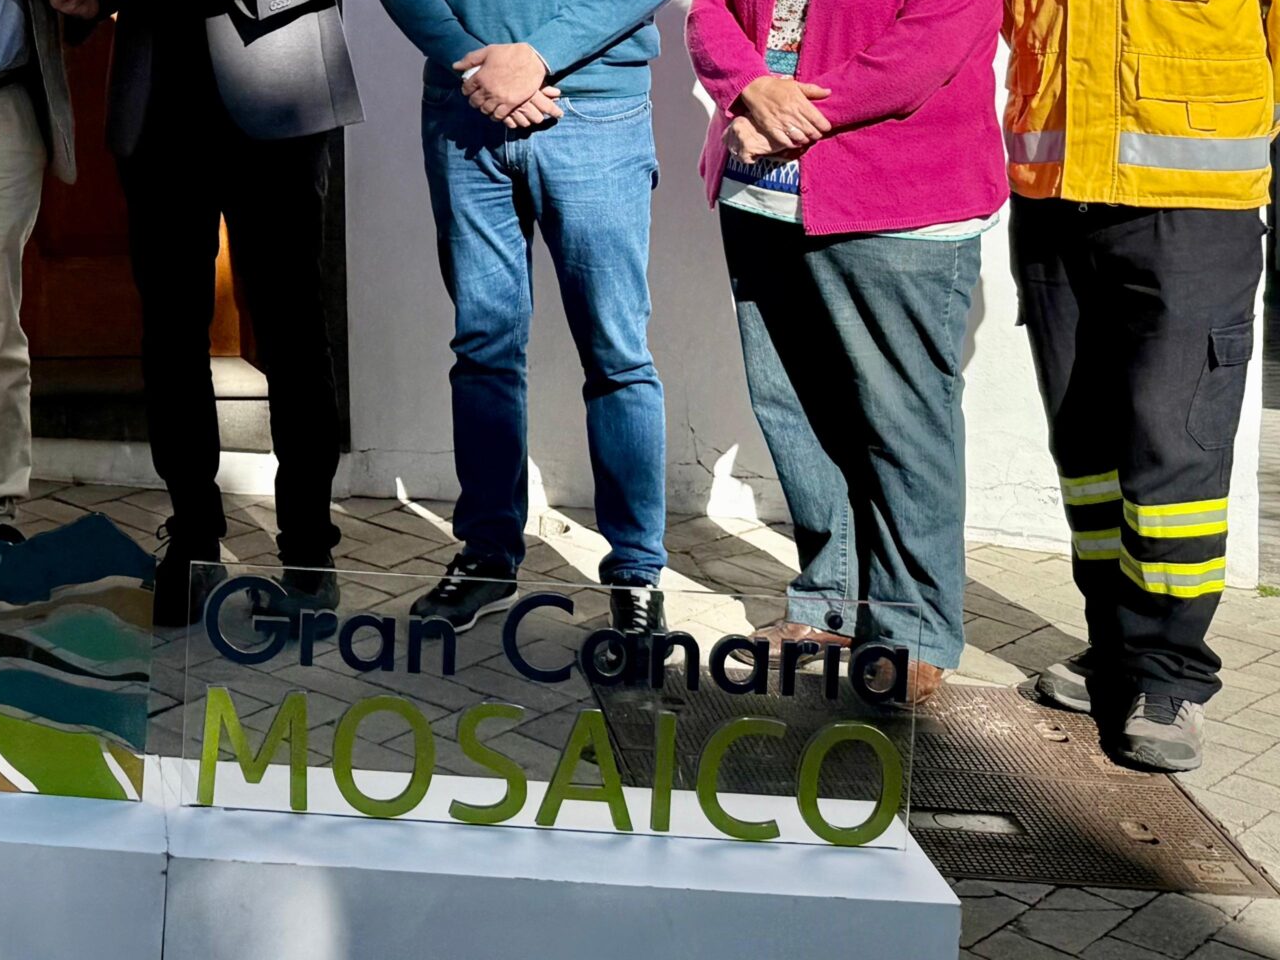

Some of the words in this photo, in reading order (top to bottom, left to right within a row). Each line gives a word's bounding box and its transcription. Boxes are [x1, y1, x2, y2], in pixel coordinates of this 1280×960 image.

[204, 575, 457, 675] Gran
[502, 592, 909, 704] Canaria
[196, 685, 905, 846] MOSAICO
